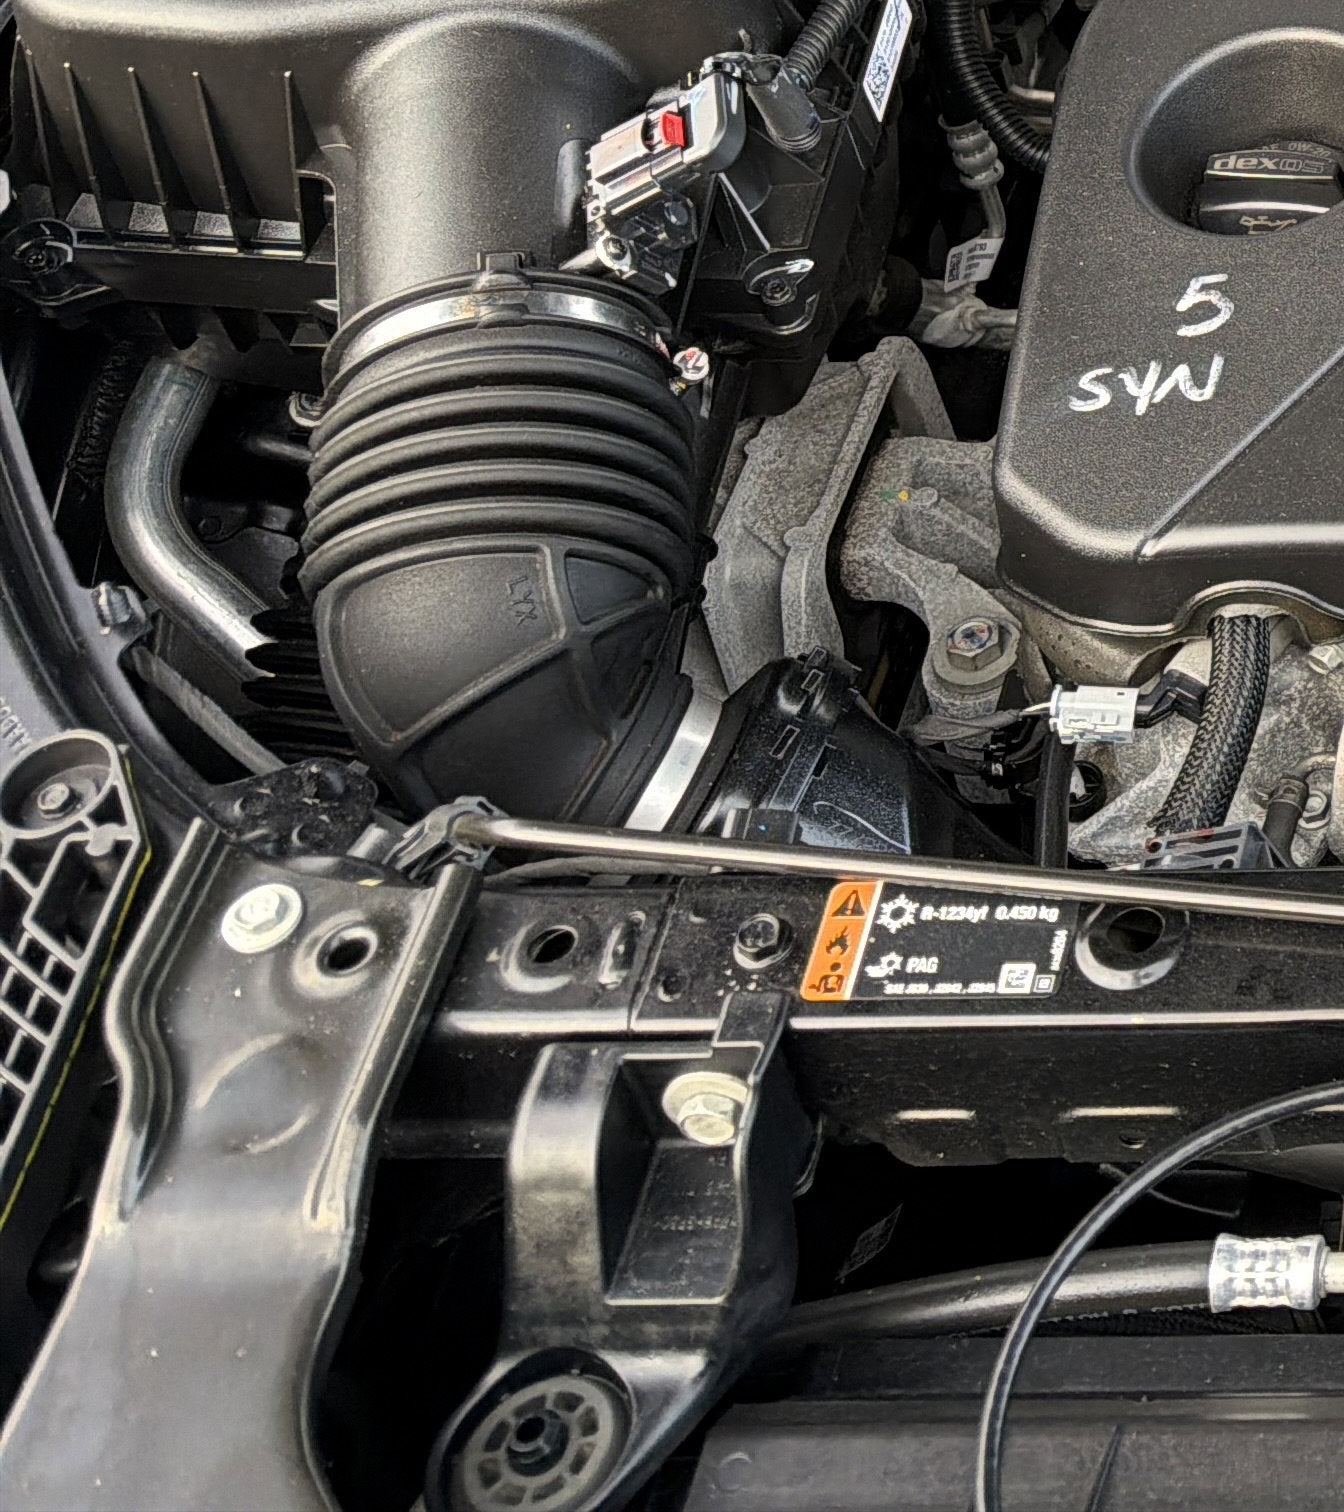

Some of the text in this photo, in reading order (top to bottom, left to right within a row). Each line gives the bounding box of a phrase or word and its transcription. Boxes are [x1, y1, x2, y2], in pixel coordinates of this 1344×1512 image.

[1287, 142, 1332, 158] 0W-20
[1213, 155, 1325, 174] dexos
[1175, 273, 1236, 338] 5
[1068, 355, 1225, 417] SYN
[919, 904, 1060, 924] R-1234yf 0.450 kg
[905, 956, 939, 974] PAG
